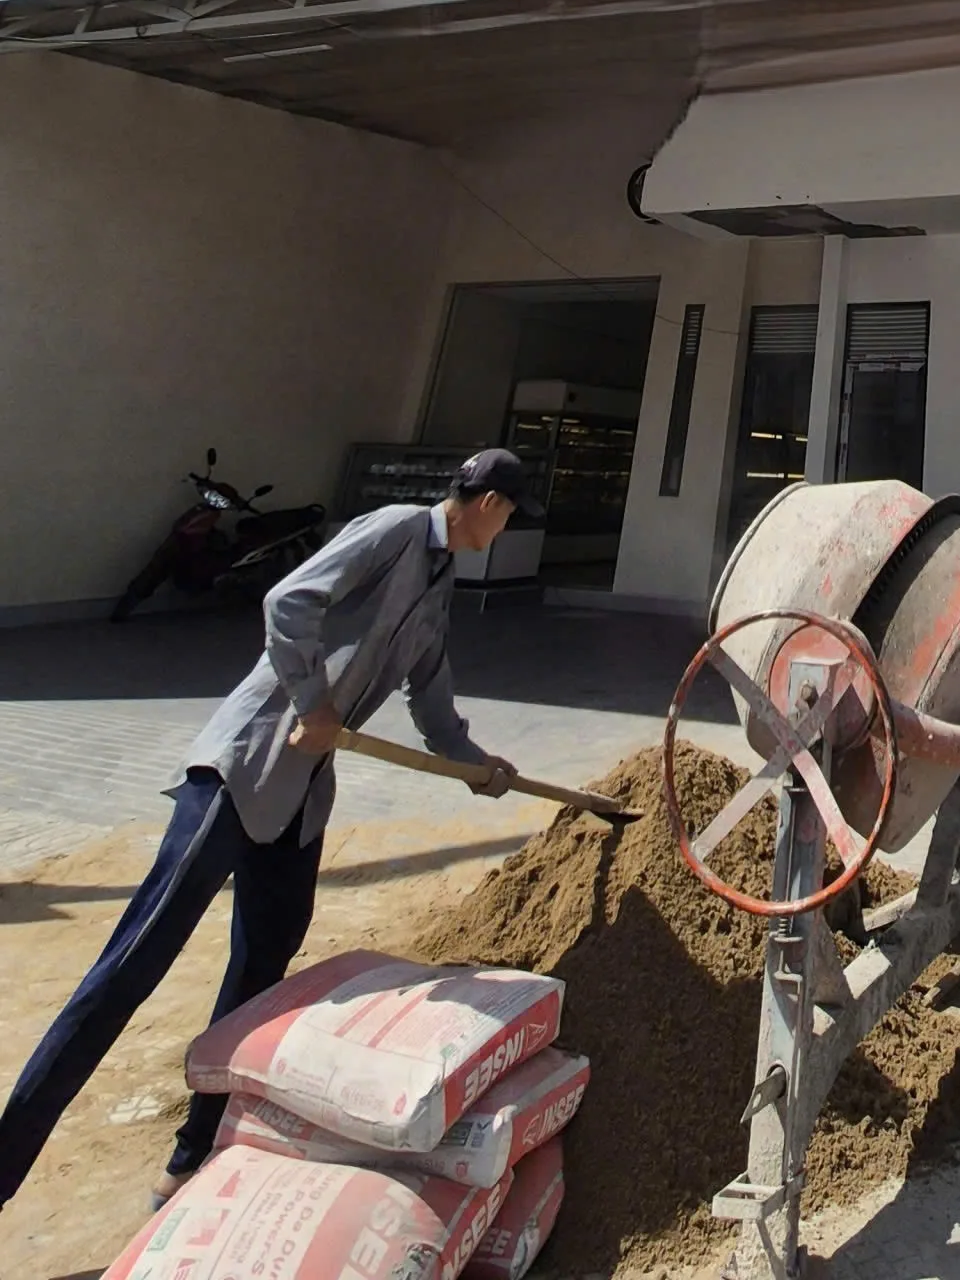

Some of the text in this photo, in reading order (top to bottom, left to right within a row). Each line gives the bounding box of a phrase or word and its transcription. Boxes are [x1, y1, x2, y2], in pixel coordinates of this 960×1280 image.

[462, 1026, 525, 1111] INSEE
[537, 1083, 585, 1142] INSEE
[441, 1183, 503, 1280] NSEE
